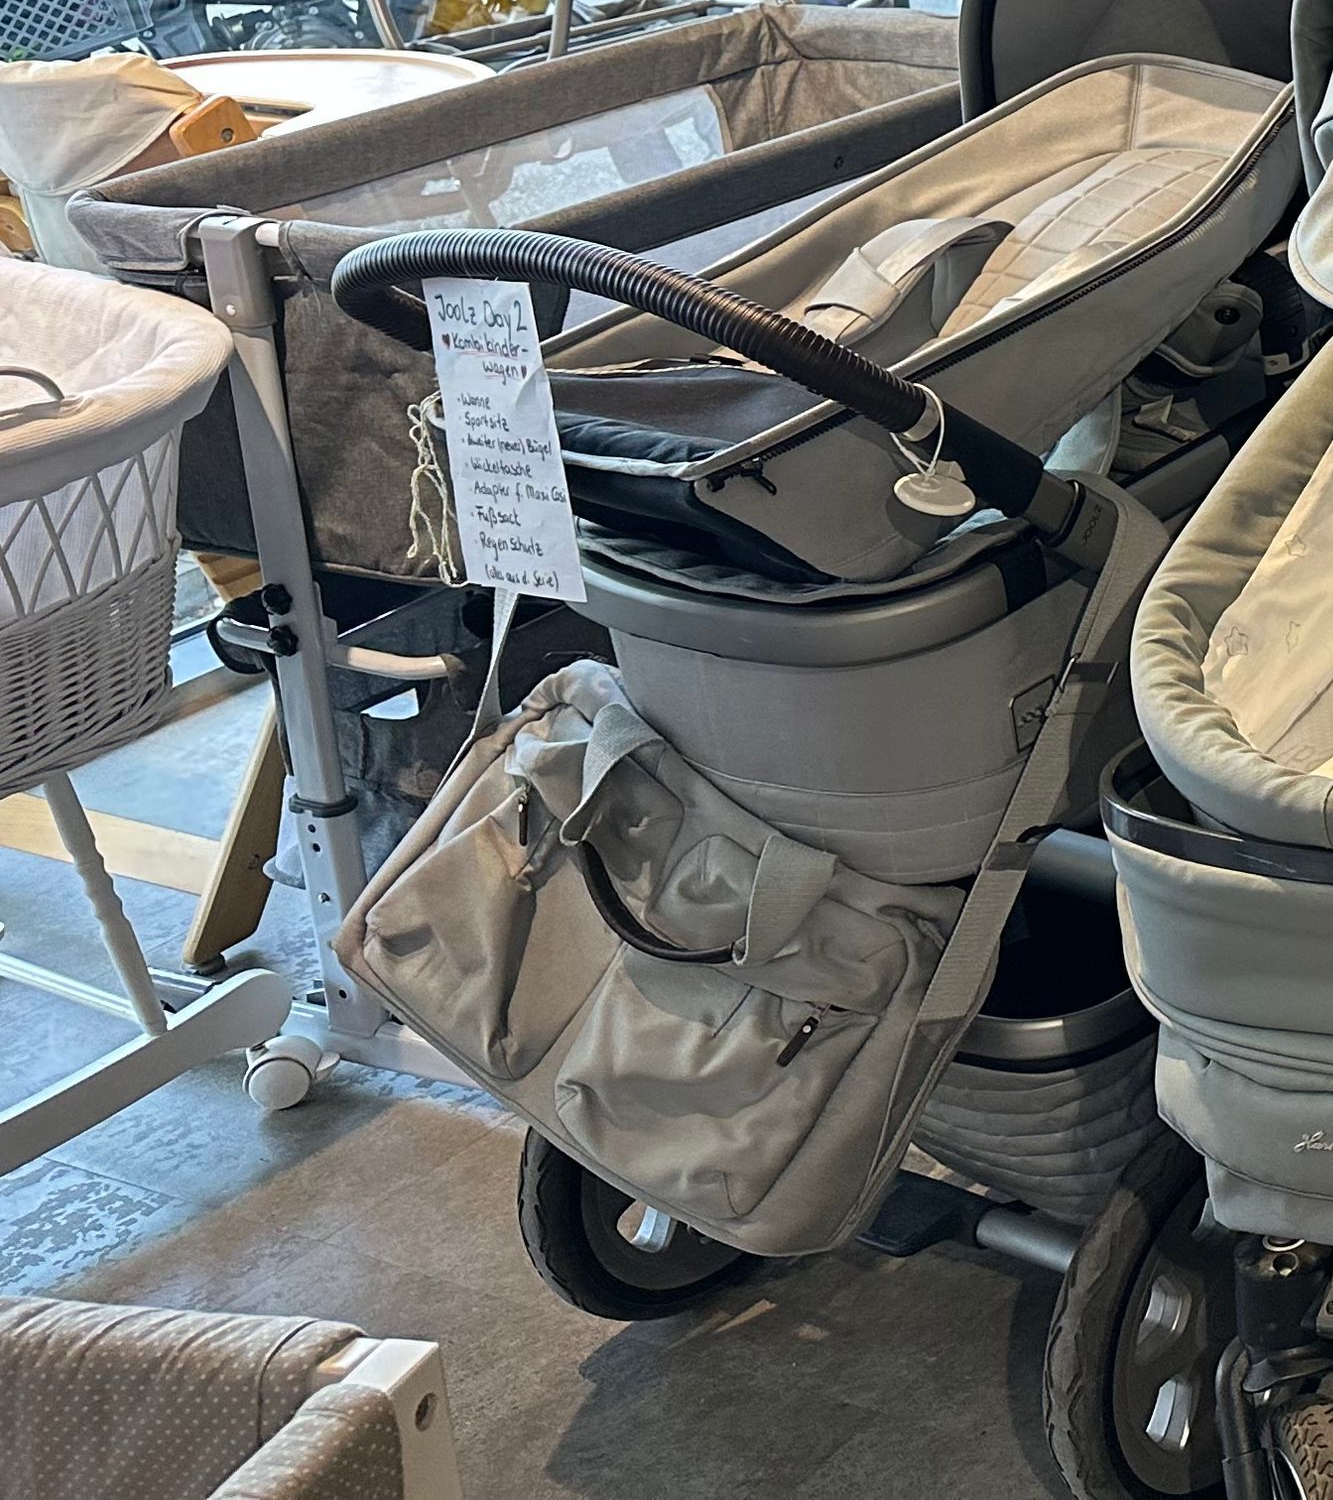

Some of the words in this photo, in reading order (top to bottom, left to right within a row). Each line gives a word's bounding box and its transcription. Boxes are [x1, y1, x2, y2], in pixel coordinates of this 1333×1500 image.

[435, 295, 477, 326] Joolz
[483, 300, 512, 342] Day
[514, 300, 527, 333] 2
[465, 411, 510, 432] Sportsitz
